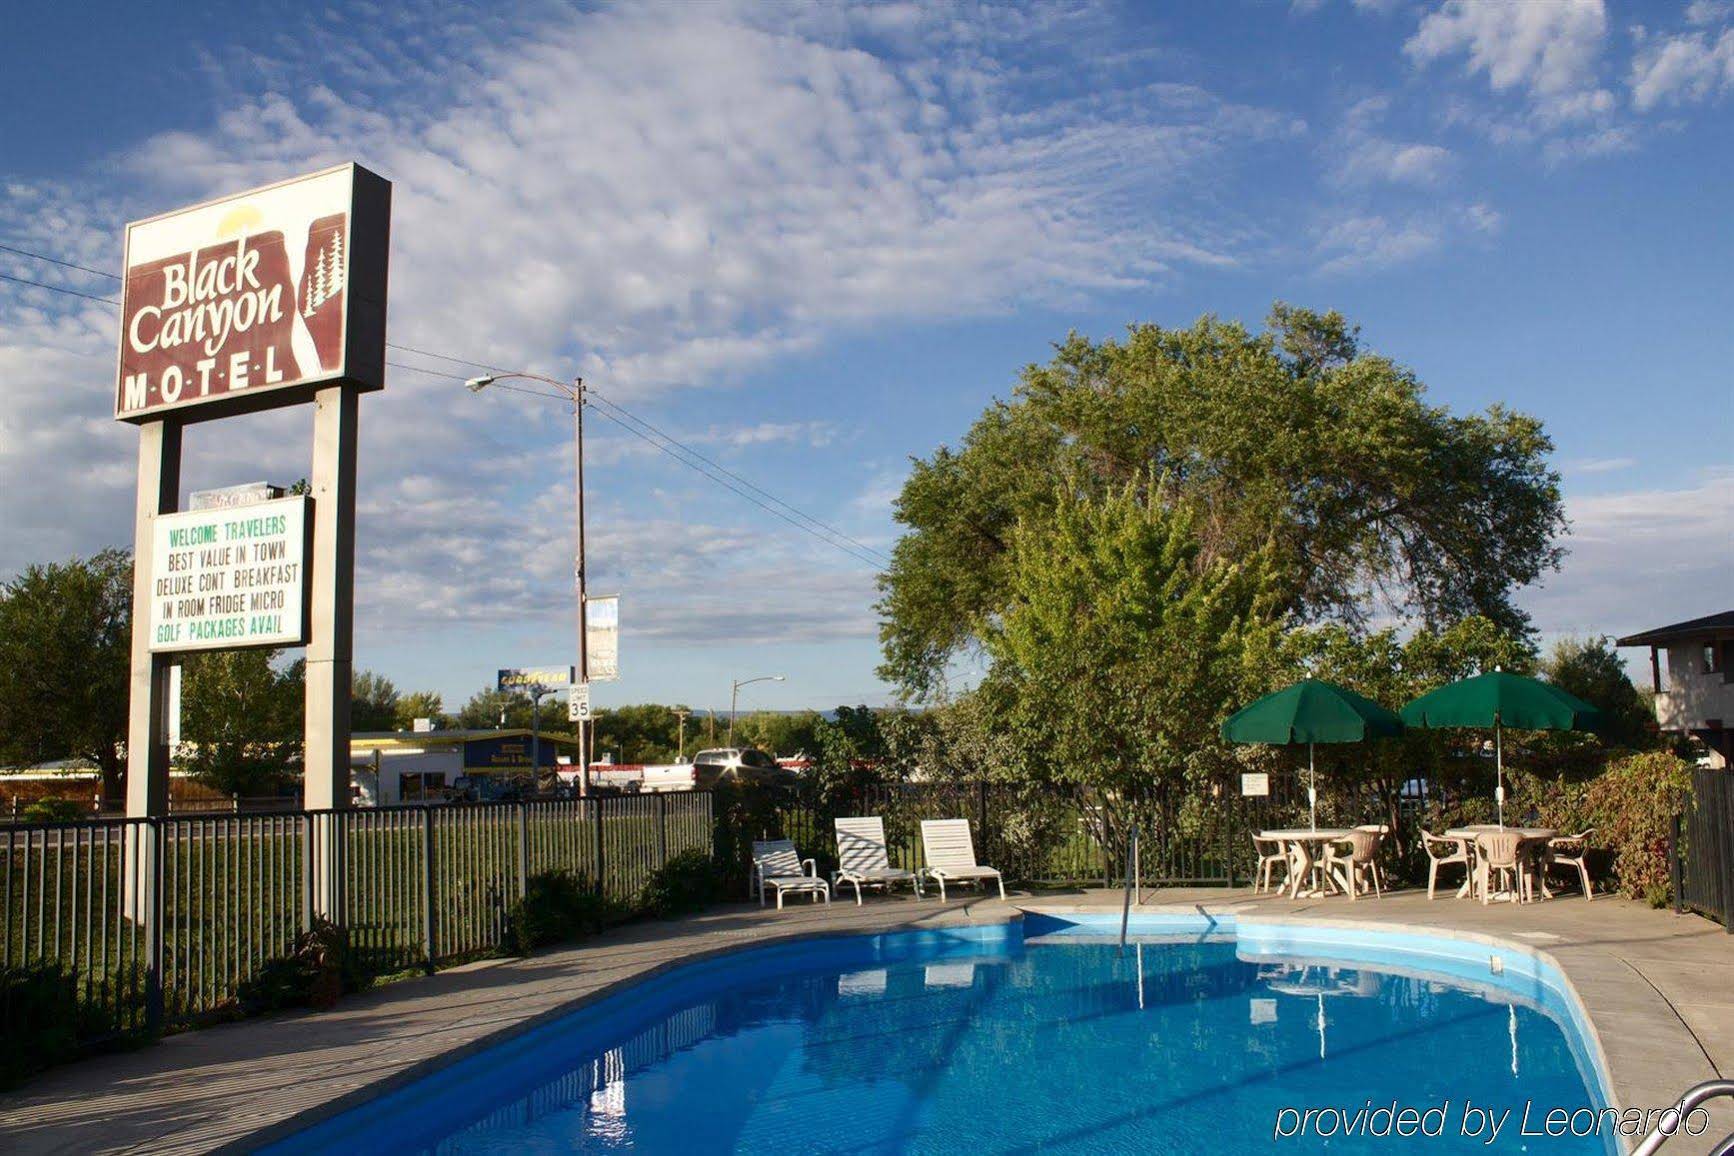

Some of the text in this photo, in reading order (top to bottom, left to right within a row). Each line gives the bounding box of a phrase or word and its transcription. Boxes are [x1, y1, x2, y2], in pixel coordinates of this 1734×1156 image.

[162, 239, 260, 310] Black
[129, 283, 283, 356] Canyon
[169, 515, 286, 548] WELCOME TRAVELERS
[168, 540, 286, 572] BEST VALUE IN TOWN
[156, 563, 298, 597] DELUXE CONT BREAKFAST
[163, 590, 284, 619] IN ROOM FRIDGE MICRO
[157, 615, 282, 643] GOLF PACKAGES AVAIL
[572, 703, 588, 716] 35
